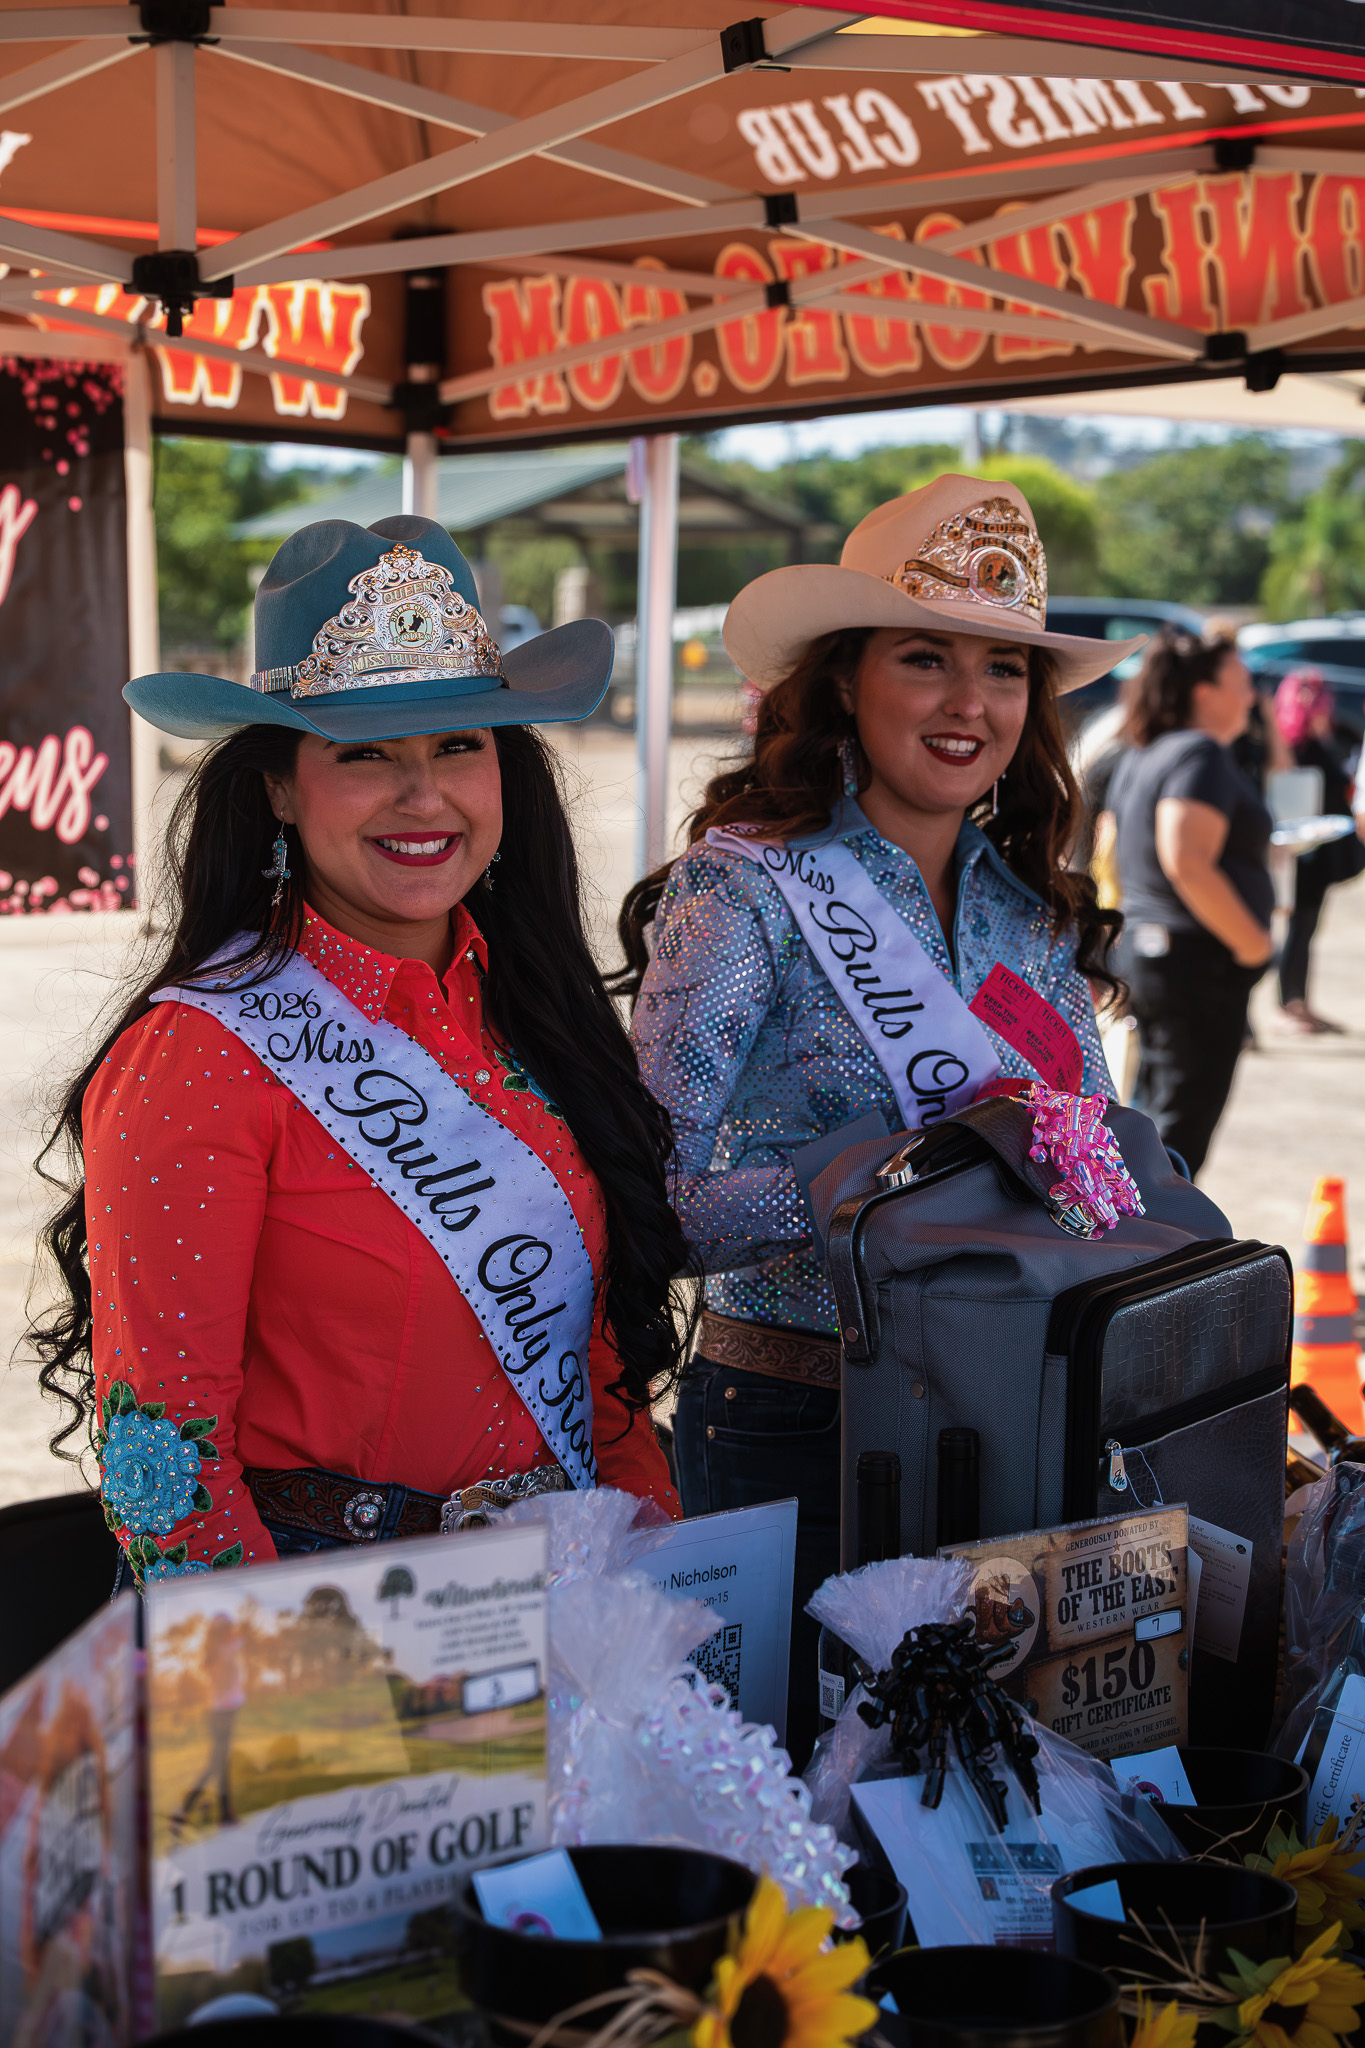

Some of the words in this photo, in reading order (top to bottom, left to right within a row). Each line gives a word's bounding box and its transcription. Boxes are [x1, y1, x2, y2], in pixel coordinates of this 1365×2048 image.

[383, 580, 432, 604] QUEEN
[352, 654, 385, 673] MISS
[389, 653, 433, 666] BULLS
[437, 656, 470, 668] ONLY
[763, 846, 835, 895] Miss
[809, 900, 925, 1040] Bulls
[999, 971, 1032, 1001] TICKET
[238, 988, 322, 1021] 2026
[983, 1001, 1012, 1027] COUPON
[1041, 1007, 1068, 1040] TICKET
[266, 1019, 376, 1064] Miss
[324, 1069, 496, 1233] Bulls
[477, 1234, 568, 1376] Only
[1065, 1531, 1112, 1553] GENEROUSLY
[1114, 1523, 1148, 1541] DONATED
[1149, 1519, 1160, 1530] BY
[670, 1565, 737, 1590] Nicholson
[1061, 1557, 1103, 1594] THE
[1108, 1540, 1172, 1582] BOOTS
[1057, 1592, 1082, 1625] OF
[1089, 1581, 1126, 1616] THE
[1131, 1565, 1179, 1604] EAST
[1077, 1611, 1126, 1633] WESTERN
[1131, 1601, 1160, 1616] WEAR
[1151, 1617, 1161, 1632] 7
[1061, 1641, 1156, 1710] $150
[1051, 1711, 1083, 1735] GIFT
[1087, 1685, 1172, 1727] CERTIFICATE
[1101, 1730, 1133, 1746] ANYTHING
[1133, 1727, 1141, 1736] IN
[1142, 1723, 1154, 1734] THE
[1155, 1716, 1177, 1730] STORE!
[1118, 1741, 1134, 1750] HATS
[1143, 1727, 1181, 1744] ACCESSORIES
[1322, 1733, 1352, 1802] Certificate
[1313, 1802, 1332, 1827] Gift
[171, 1878, 188, 1924] 1
[206, 1843, 362, 1918] ROUND
[371, 1832, 418, 1878] OF
[429, 1800, 536, 1867] GOLF
